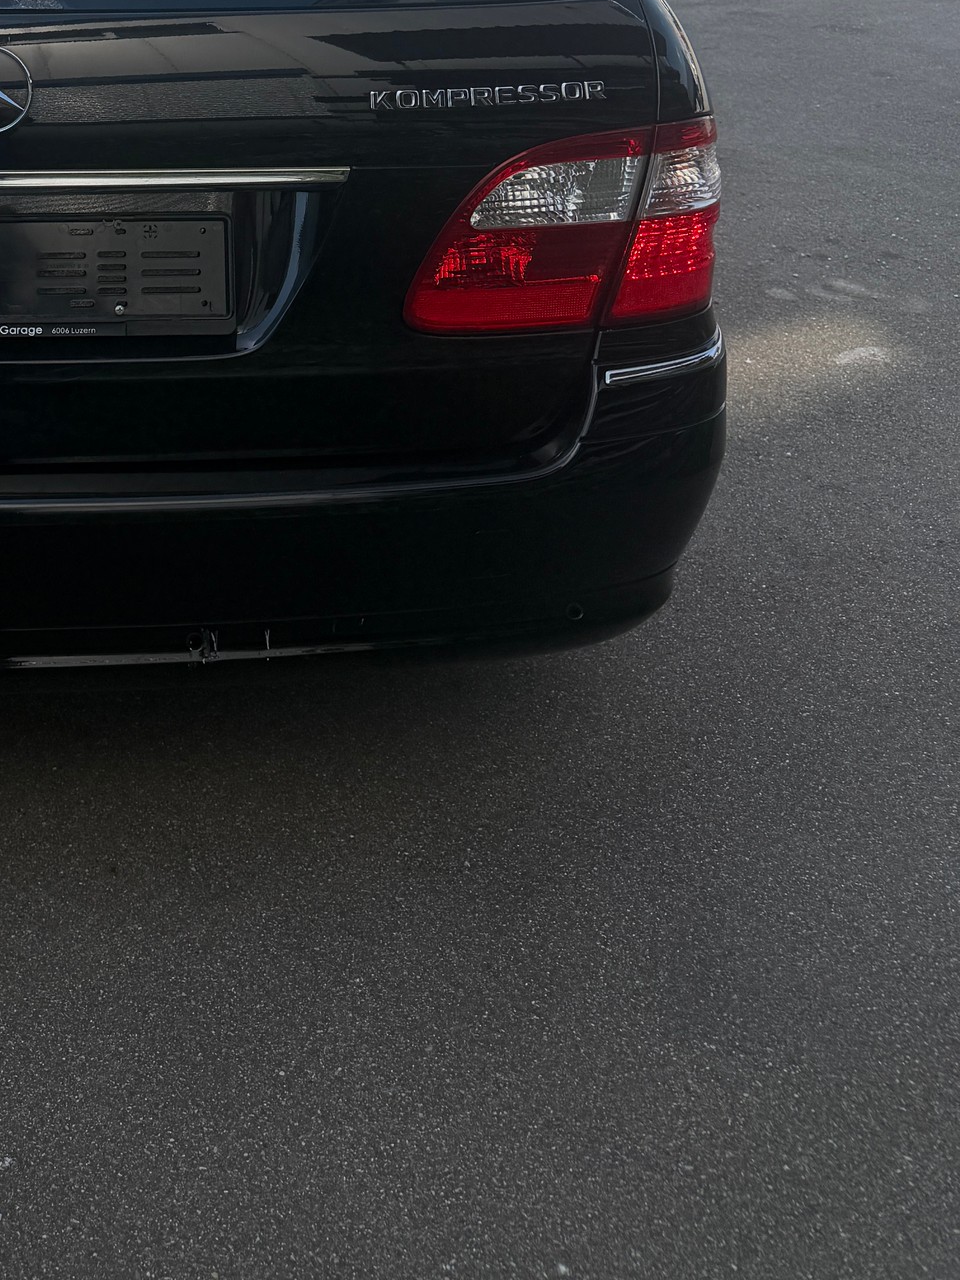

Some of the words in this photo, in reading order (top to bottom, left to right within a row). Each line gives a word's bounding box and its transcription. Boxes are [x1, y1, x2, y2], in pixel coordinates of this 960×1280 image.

[369, 80, 607, 111] KOMPRESSOR
[0, 325, 43, 337] Garage
[51, 327, 70, 335] 6006
[70, 327, 97, 335] Luzern
